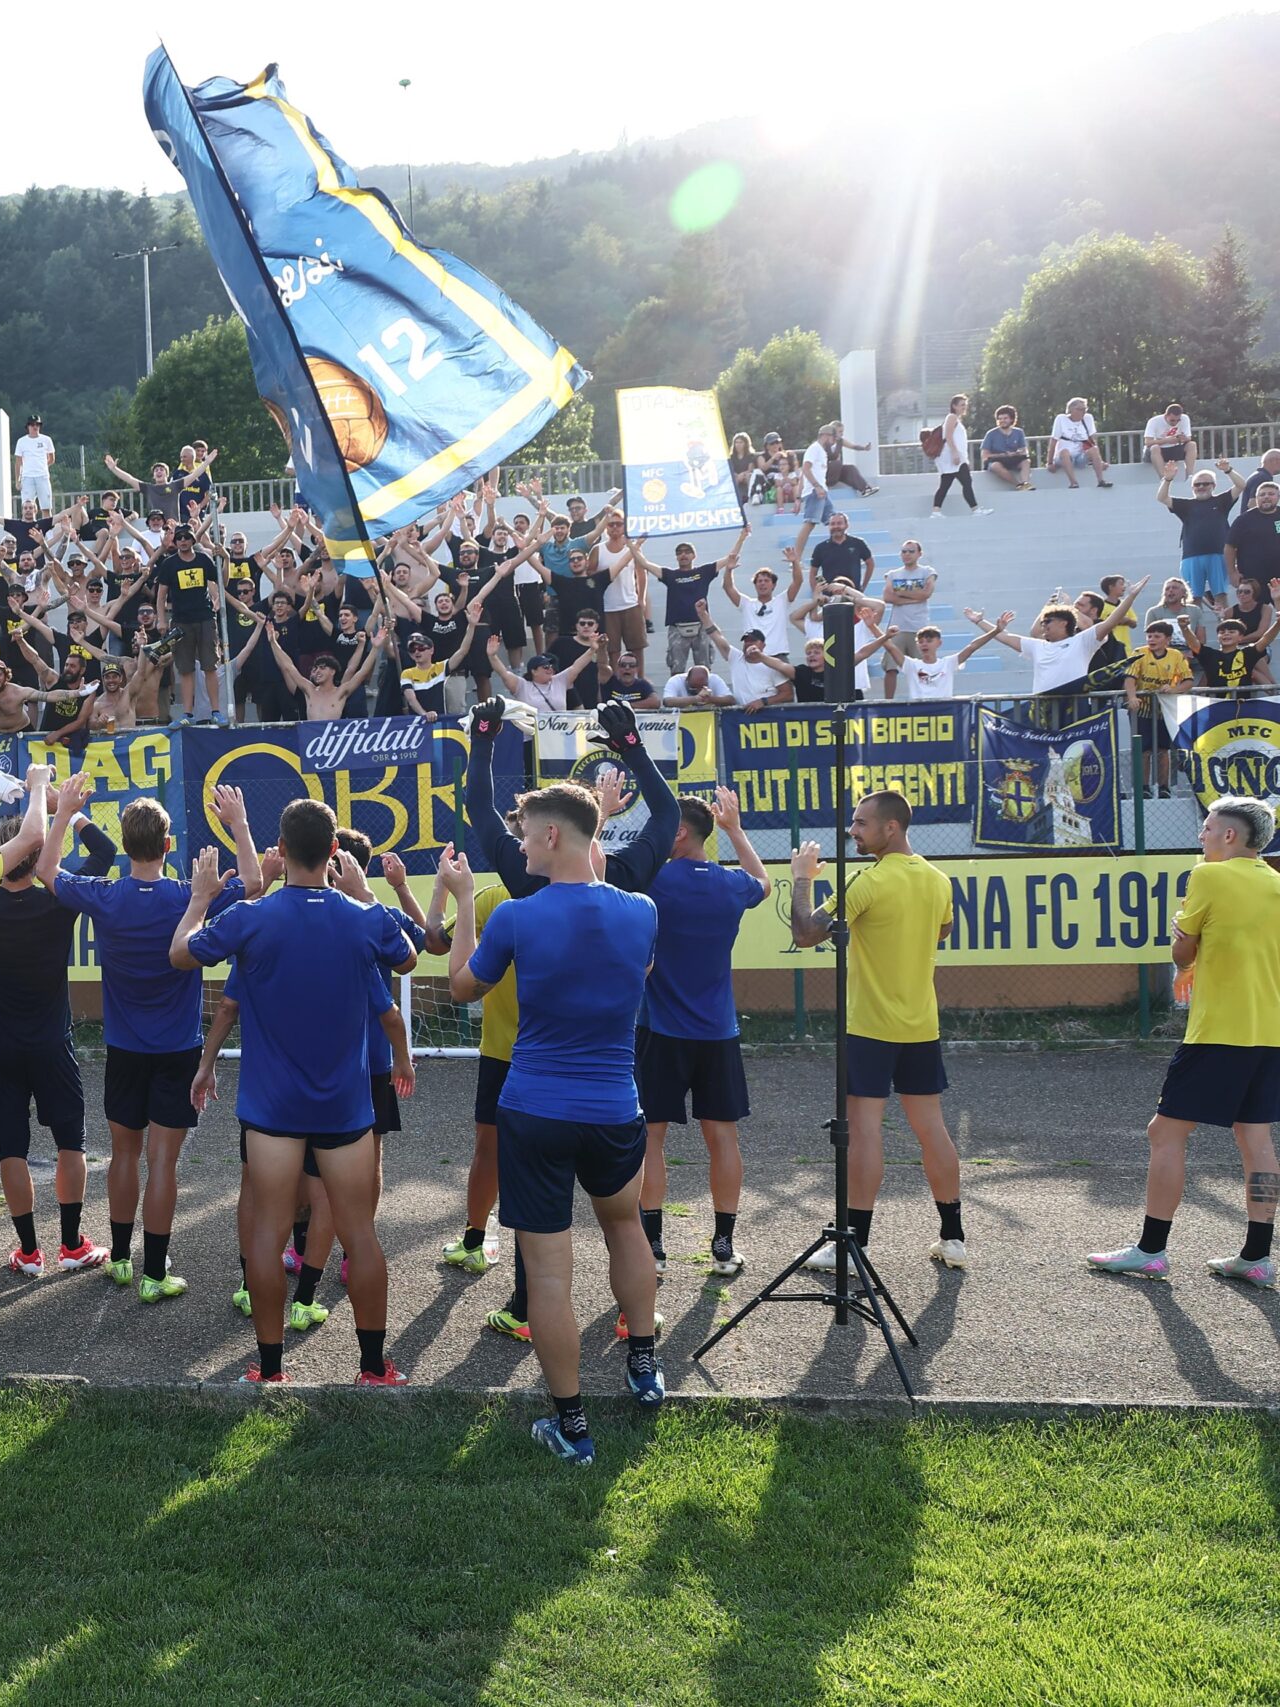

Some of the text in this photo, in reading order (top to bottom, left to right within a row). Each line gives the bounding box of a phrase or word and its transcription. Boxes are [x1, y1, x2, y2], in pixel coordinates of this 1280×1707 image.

[357, 317, 444, 397] 12
[641, 468, 665, 478] MFC
[626, 507, 743, 533] DIPENDENTE
[644, 503, 666, 513] 1912
[538, 716, 569, 731] Non
[638, 719, 677, 731] venire
[740, 722, 779, 749] NOI
[786, 721, 809, 747] DI
[872, 715, 954, 744] BIAGIO
[1227, 725, 1272, 739] MFC
[305, 716, 426, 770] diffidati
[732, 768, 820, 813] TUTTI
[1026, 872, 1079, 949] FC
